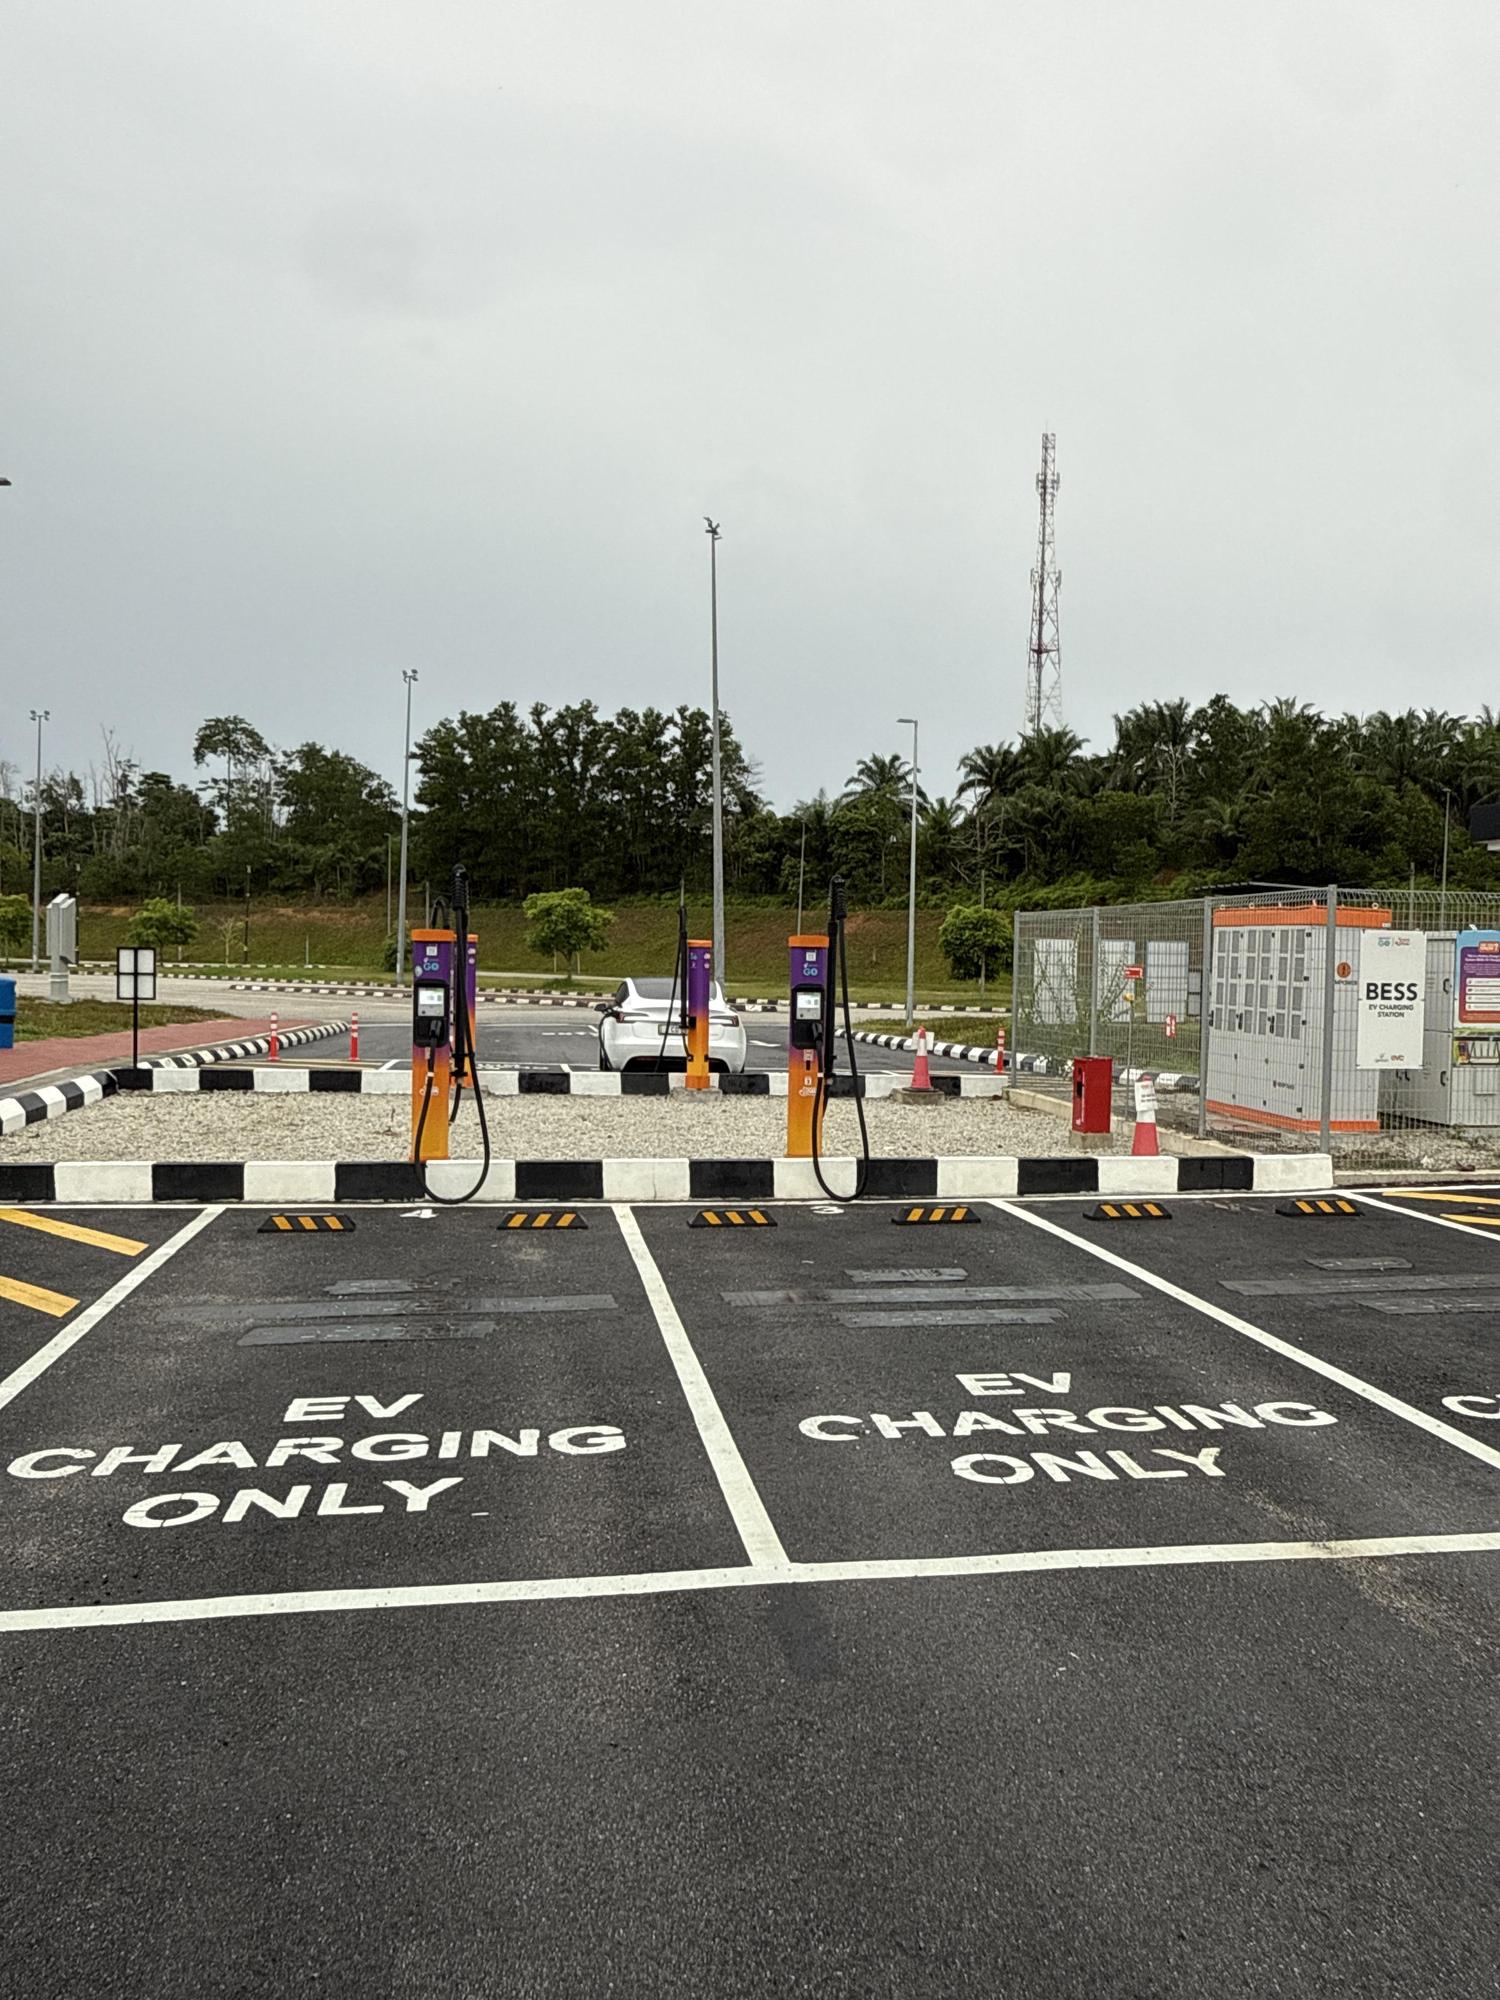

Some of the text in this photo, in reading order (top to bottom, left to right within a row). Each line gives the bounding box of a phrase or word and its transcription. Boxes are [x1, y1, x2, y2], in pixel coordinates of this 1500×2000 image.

[423, 962, 439, 971] GO
[803, 968, 818, 976] GO
[1366, 983, 1418, 1001] BESS
[955, 1372, 1071, 1397] EV
[284, 1394, 423, 1422] EV
[799, 1402, 1338, 1442] CHARGING
[7, 1426, 626, 1478] CHARGING
[951, 1448, 1225, 1484] ONLY
[123, 1478, 463, 1527] ONLY
